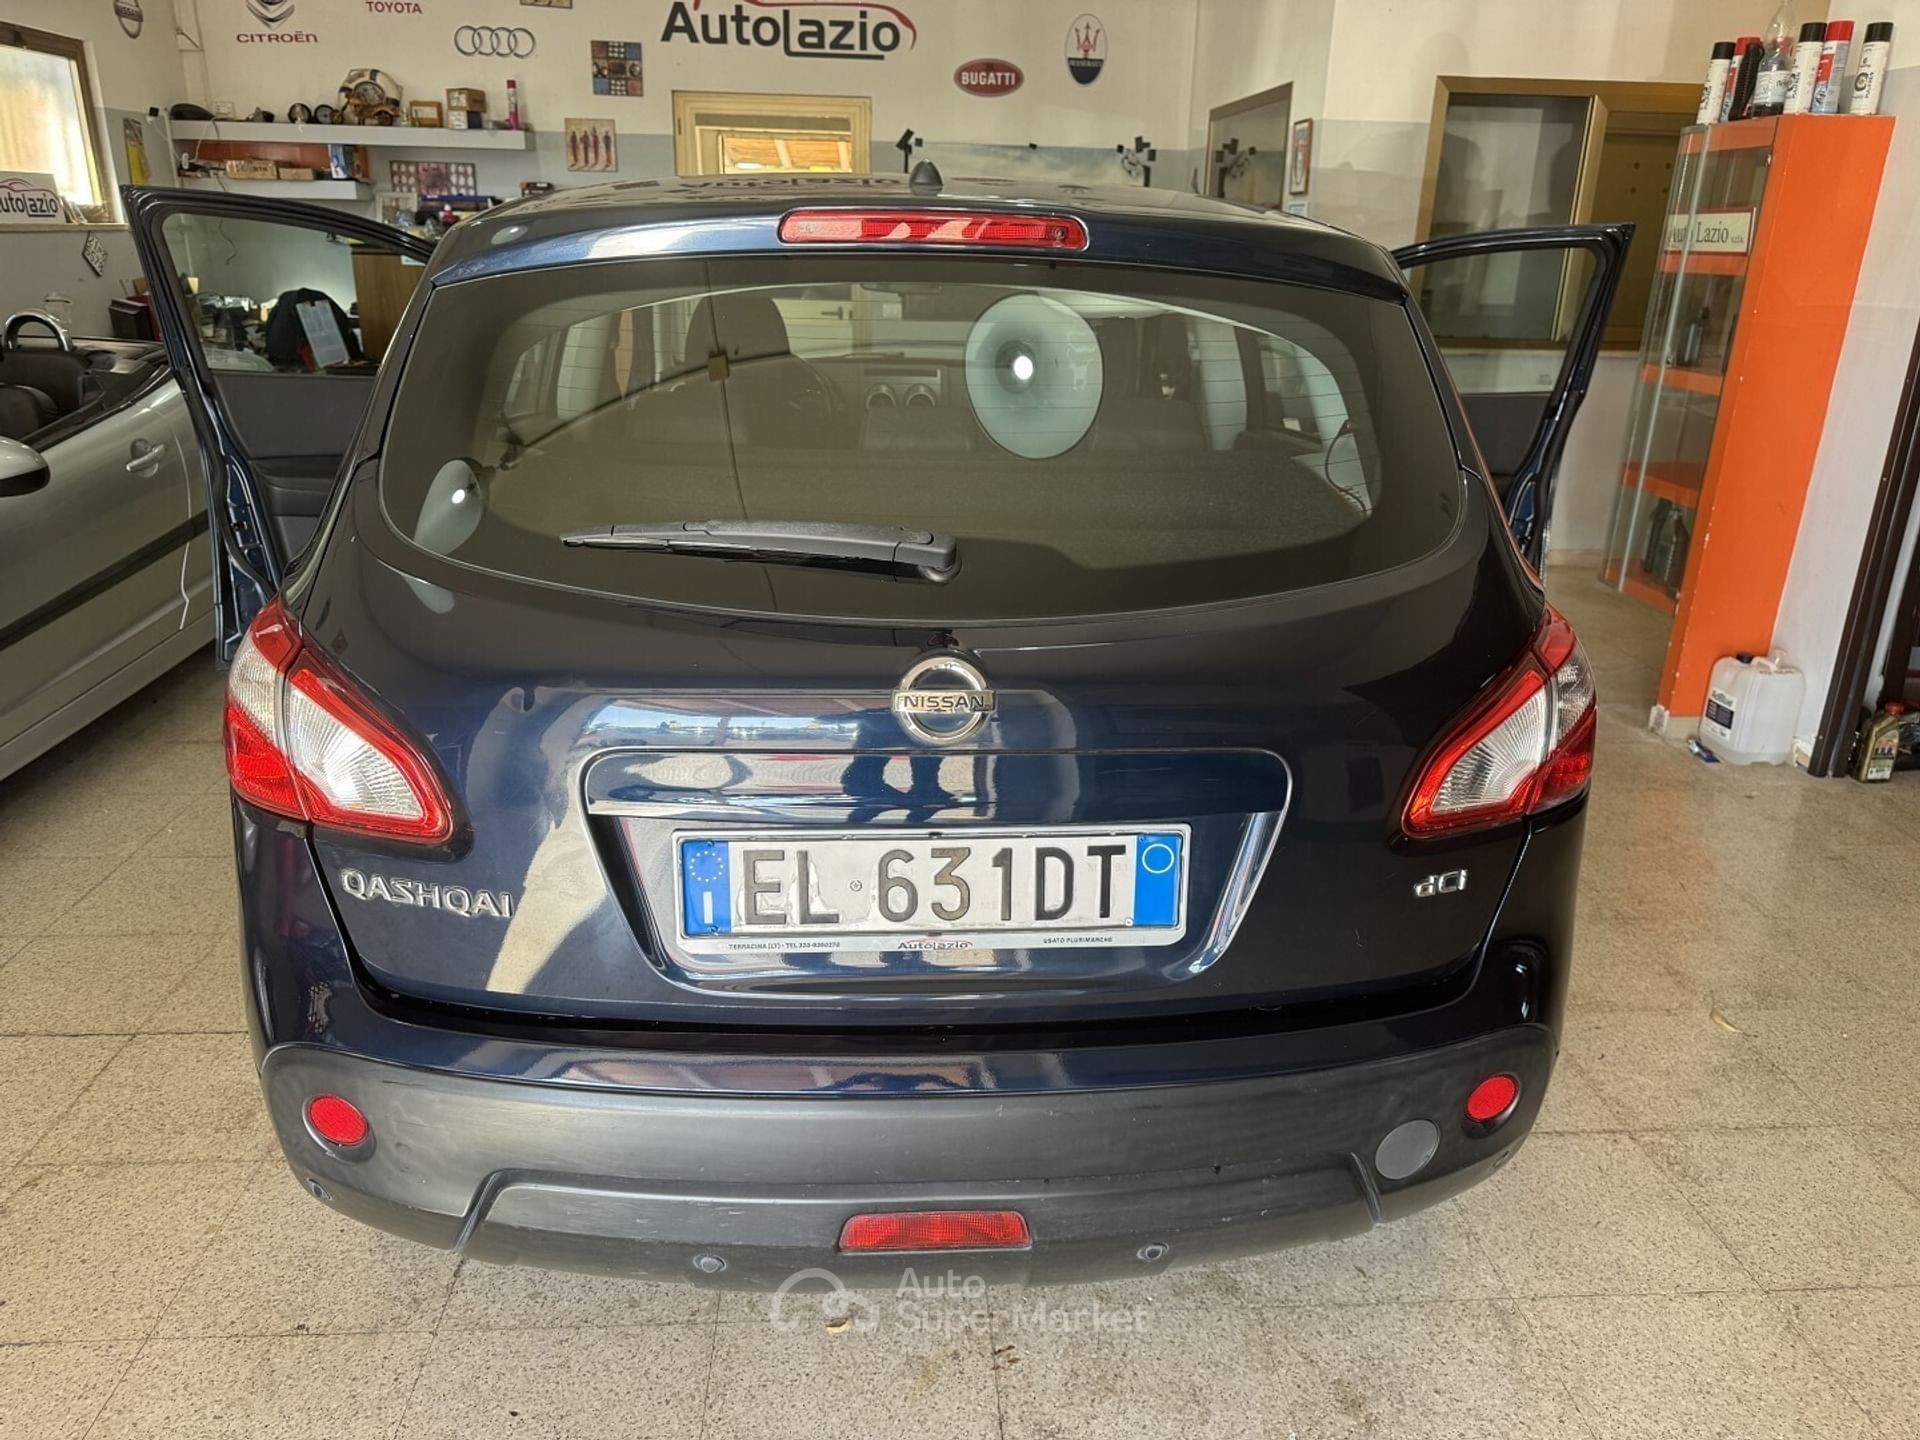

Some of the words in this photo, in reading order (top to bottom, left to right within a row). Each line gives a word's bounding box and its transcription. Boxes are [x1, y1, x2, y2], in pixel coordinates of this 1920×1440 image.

[366, 1, 422, 14] TOYOTA
[961, 72, 1016, 86] BUGATTI
[1696, 220, 1729, 243] Lazio
[903, 695, 984, 708] NISSAN
[340, 868, 513, 917] QASHQAI
[743, 849, 840, 925] EL
[878, 845, 1127, 923] 631DT
